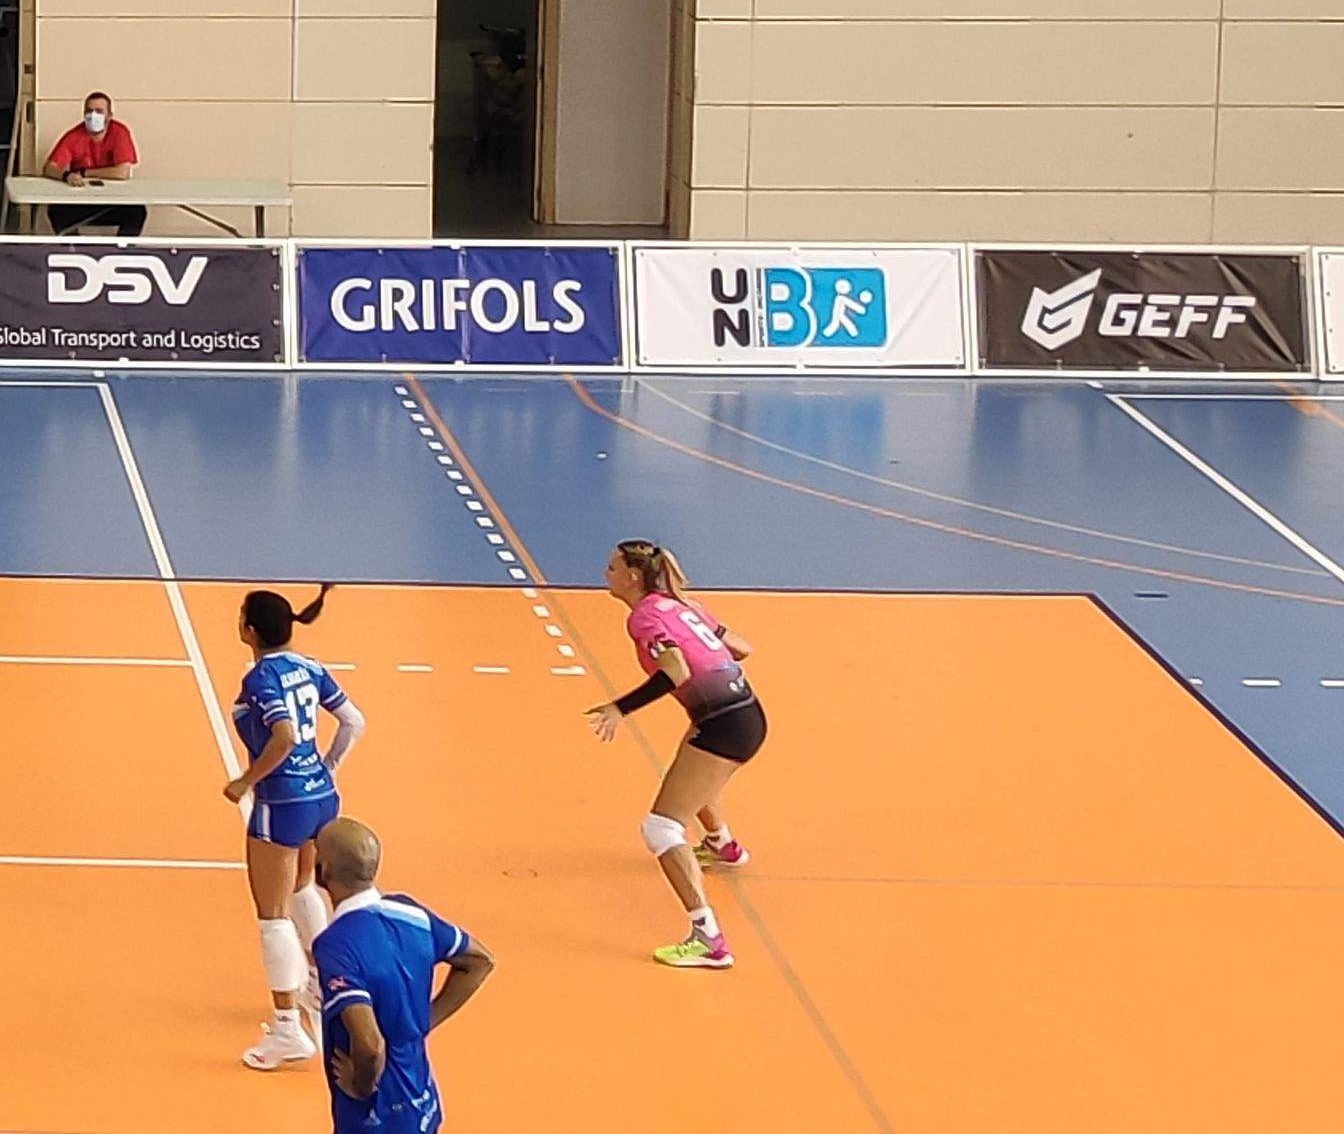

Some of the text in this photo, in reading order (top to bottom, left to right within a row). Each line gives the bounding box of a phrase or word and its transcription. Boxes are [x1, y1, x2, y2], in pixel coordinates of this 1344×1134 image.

[47, 254, 208, 305] DSV
[330, 277, 586, 334] GRIFOLS
[1098, 293, 1256, 339] GEFF
[52, 328, 137, 350] Transport
[142, 329, 176, 348] and
[180, 330, 261, 352] Logistics
[285, 683, 320, 745] 13
